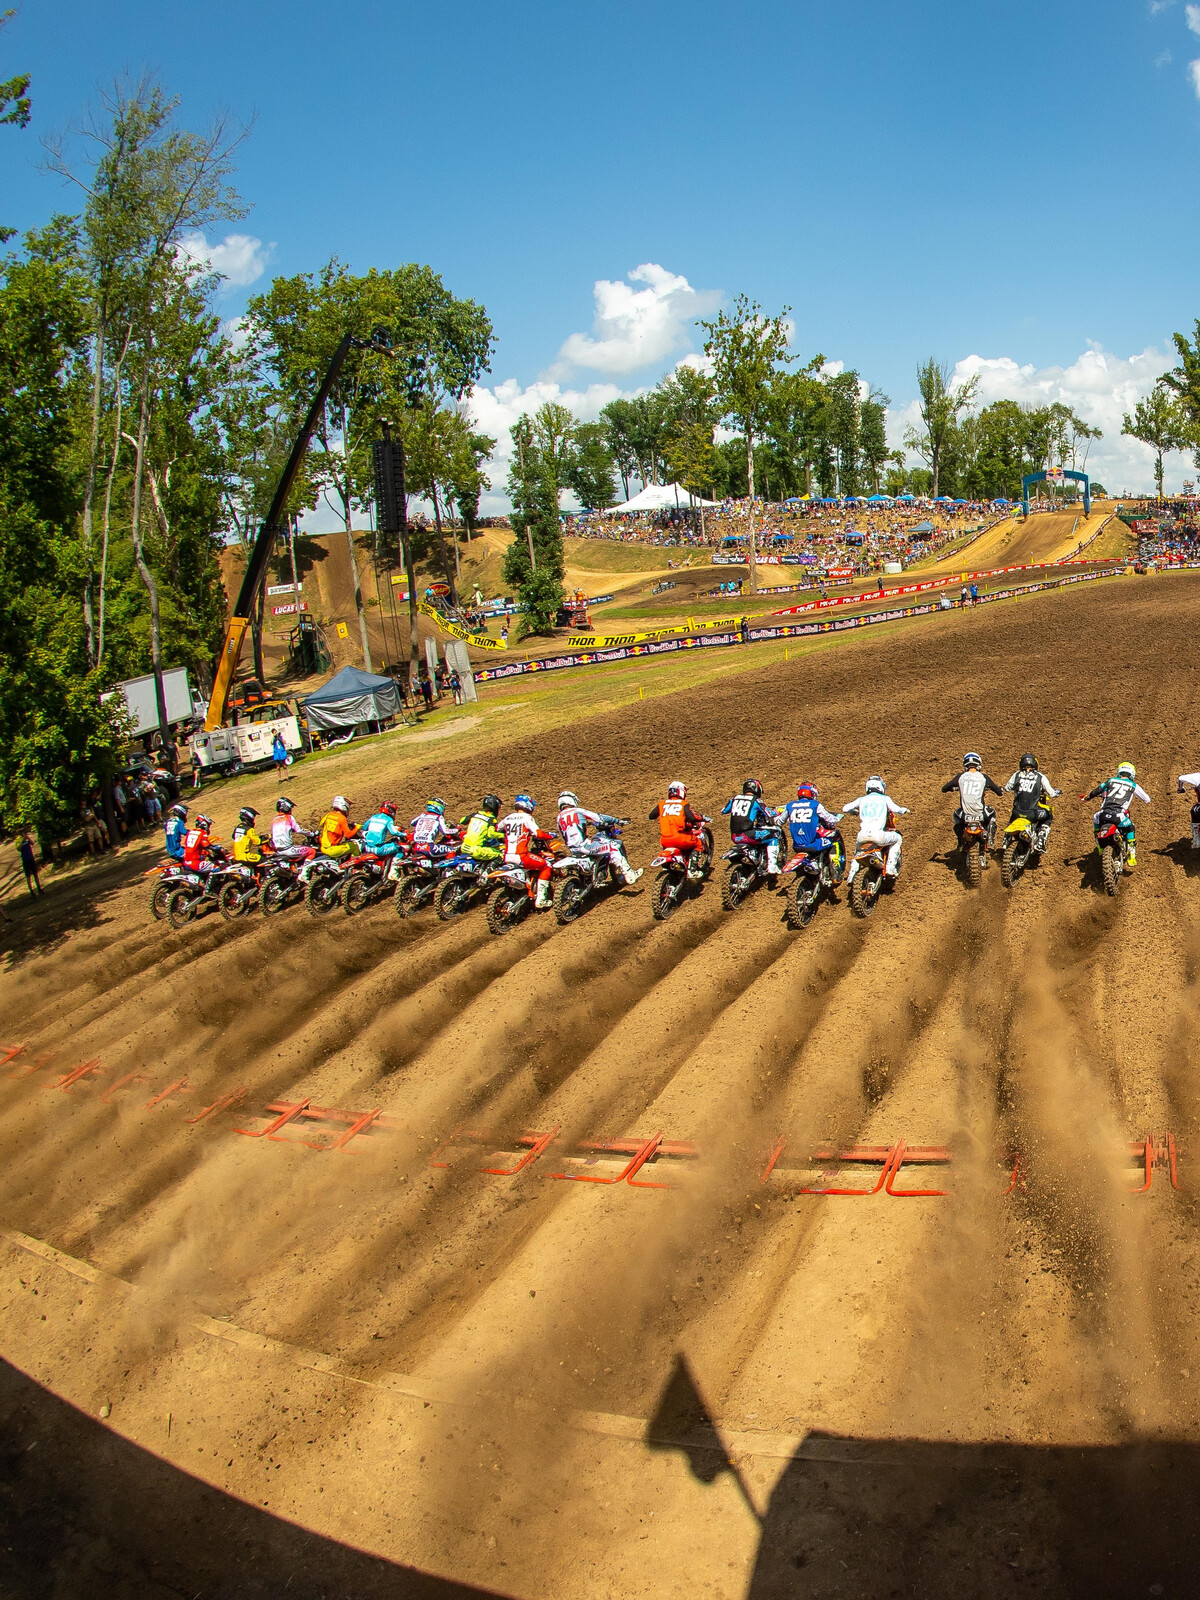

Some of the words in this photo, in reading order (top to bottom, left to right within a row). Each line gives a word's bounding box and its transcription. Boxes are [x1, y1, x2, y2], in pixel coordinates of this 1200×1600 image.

[275, 605, 294, 614] LUCAS
[452, 627, 469, 642] THOR
[604, 636, 635, 646] THOR
[963, 781, 981, 794] 112
[1019, 779, 1036, 793] 380
[1108, 784, 1130, 798] 75
[663, 804, 682, 816] 742
[560, 813, 579, 831] 544
[505, 823, 522, 836] 841
